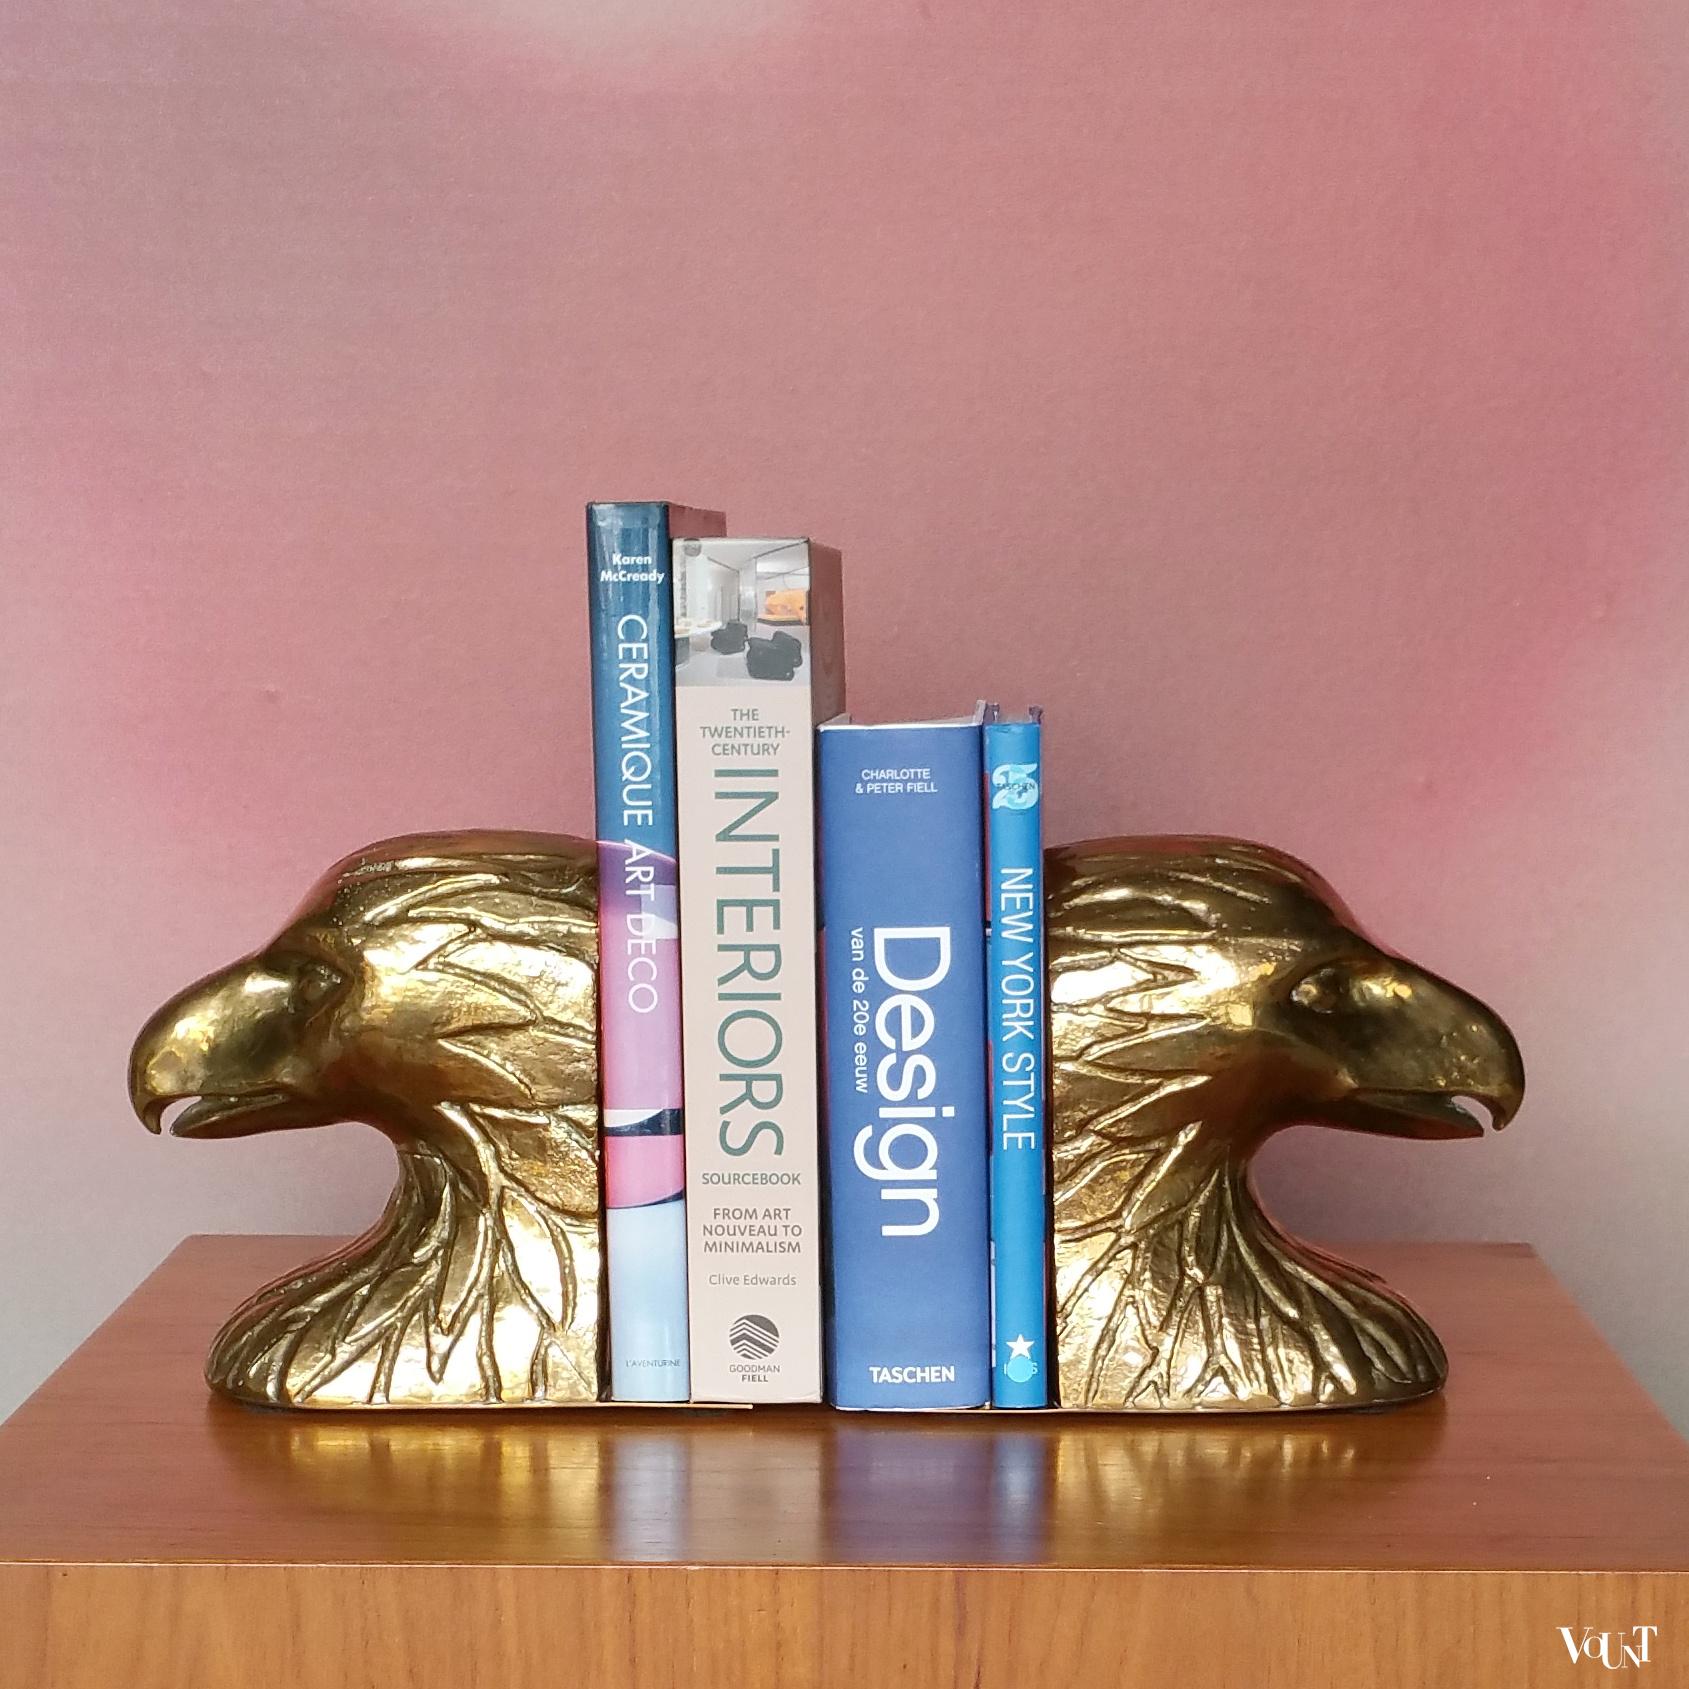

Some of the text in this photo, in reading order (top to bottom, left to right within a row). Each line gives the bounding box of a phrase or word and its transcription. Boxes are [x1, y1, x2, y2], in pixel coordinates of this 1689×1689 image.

[612, 553, 652, 566] Karen
[600, 569, 665, 585] McCready
[731, 708, 759, 721] THE
[700, 727, 790, 739] TWENTIETH-
[711, 743, 780, 756] CENTURY
[861, 768, 931, 780] CHARLOTTE
[855, 782, 938, 794] & PETER FIELL
[617, 614, 658, 1014] CERAMIQUE ART DECO
[714, 769, 785, 1156] INTERIORS
[850, 927, 870, 1094] van de 20e eeuw
[1000, 867, 1036, 1151] NEW YORK STYLE
[853, 926, 955, 1237] Design
[702, 1173, 801, 1185] SOURCEBOOK
[713, 1208, 791, 1220] FROM ART
[702, 1225, 802, 1237] NOUVEAU TO
[703, 1241, 801, 1253] MINIMALISM
[708, 1274, 797, 1286] Clive Edwards
[729, 1365, 781, 1373] GOODMAN
[869, 1366, 956, 1384] TASCHEN
[741, 1375, 769, 1383] FIELL
